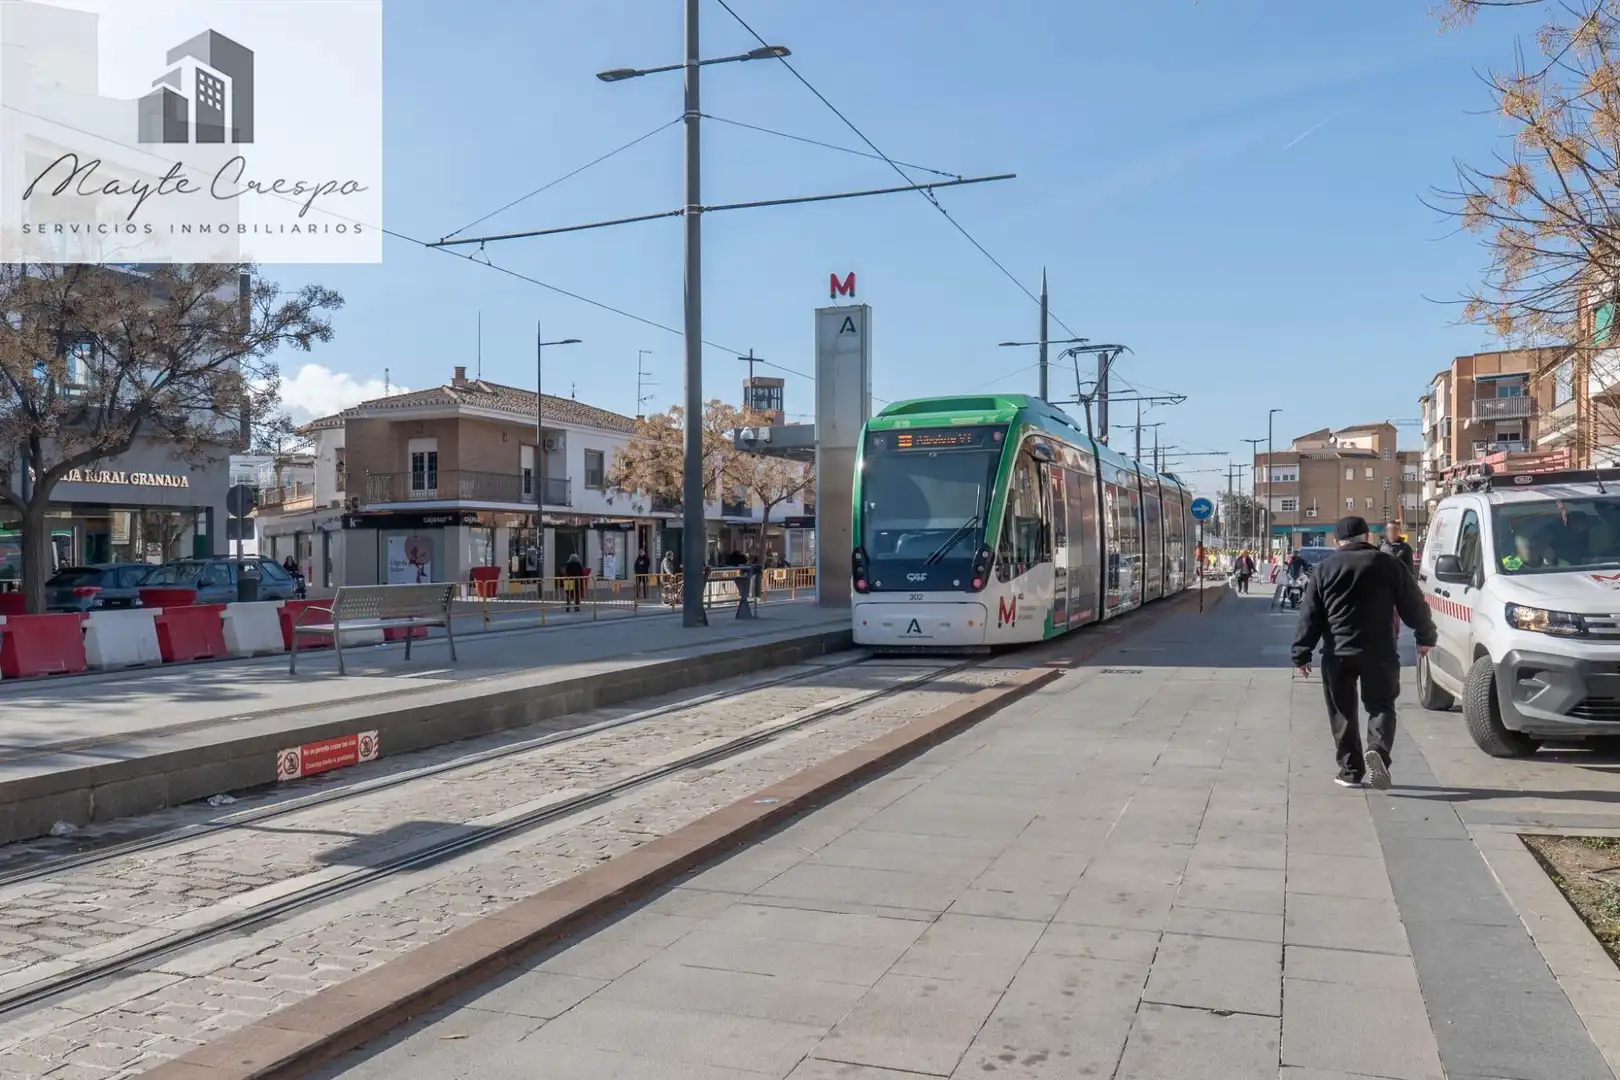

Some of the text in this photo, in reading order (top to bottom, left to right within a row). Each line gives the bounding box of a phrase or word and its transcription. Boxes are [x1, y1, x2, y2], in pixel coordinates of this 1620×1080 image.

[830, 272, 855, 299] M
[85, 469, 129, 484] RURAL
[130, 472, 189, 488] GRANADA
[909, 593, 924, 601] 302
